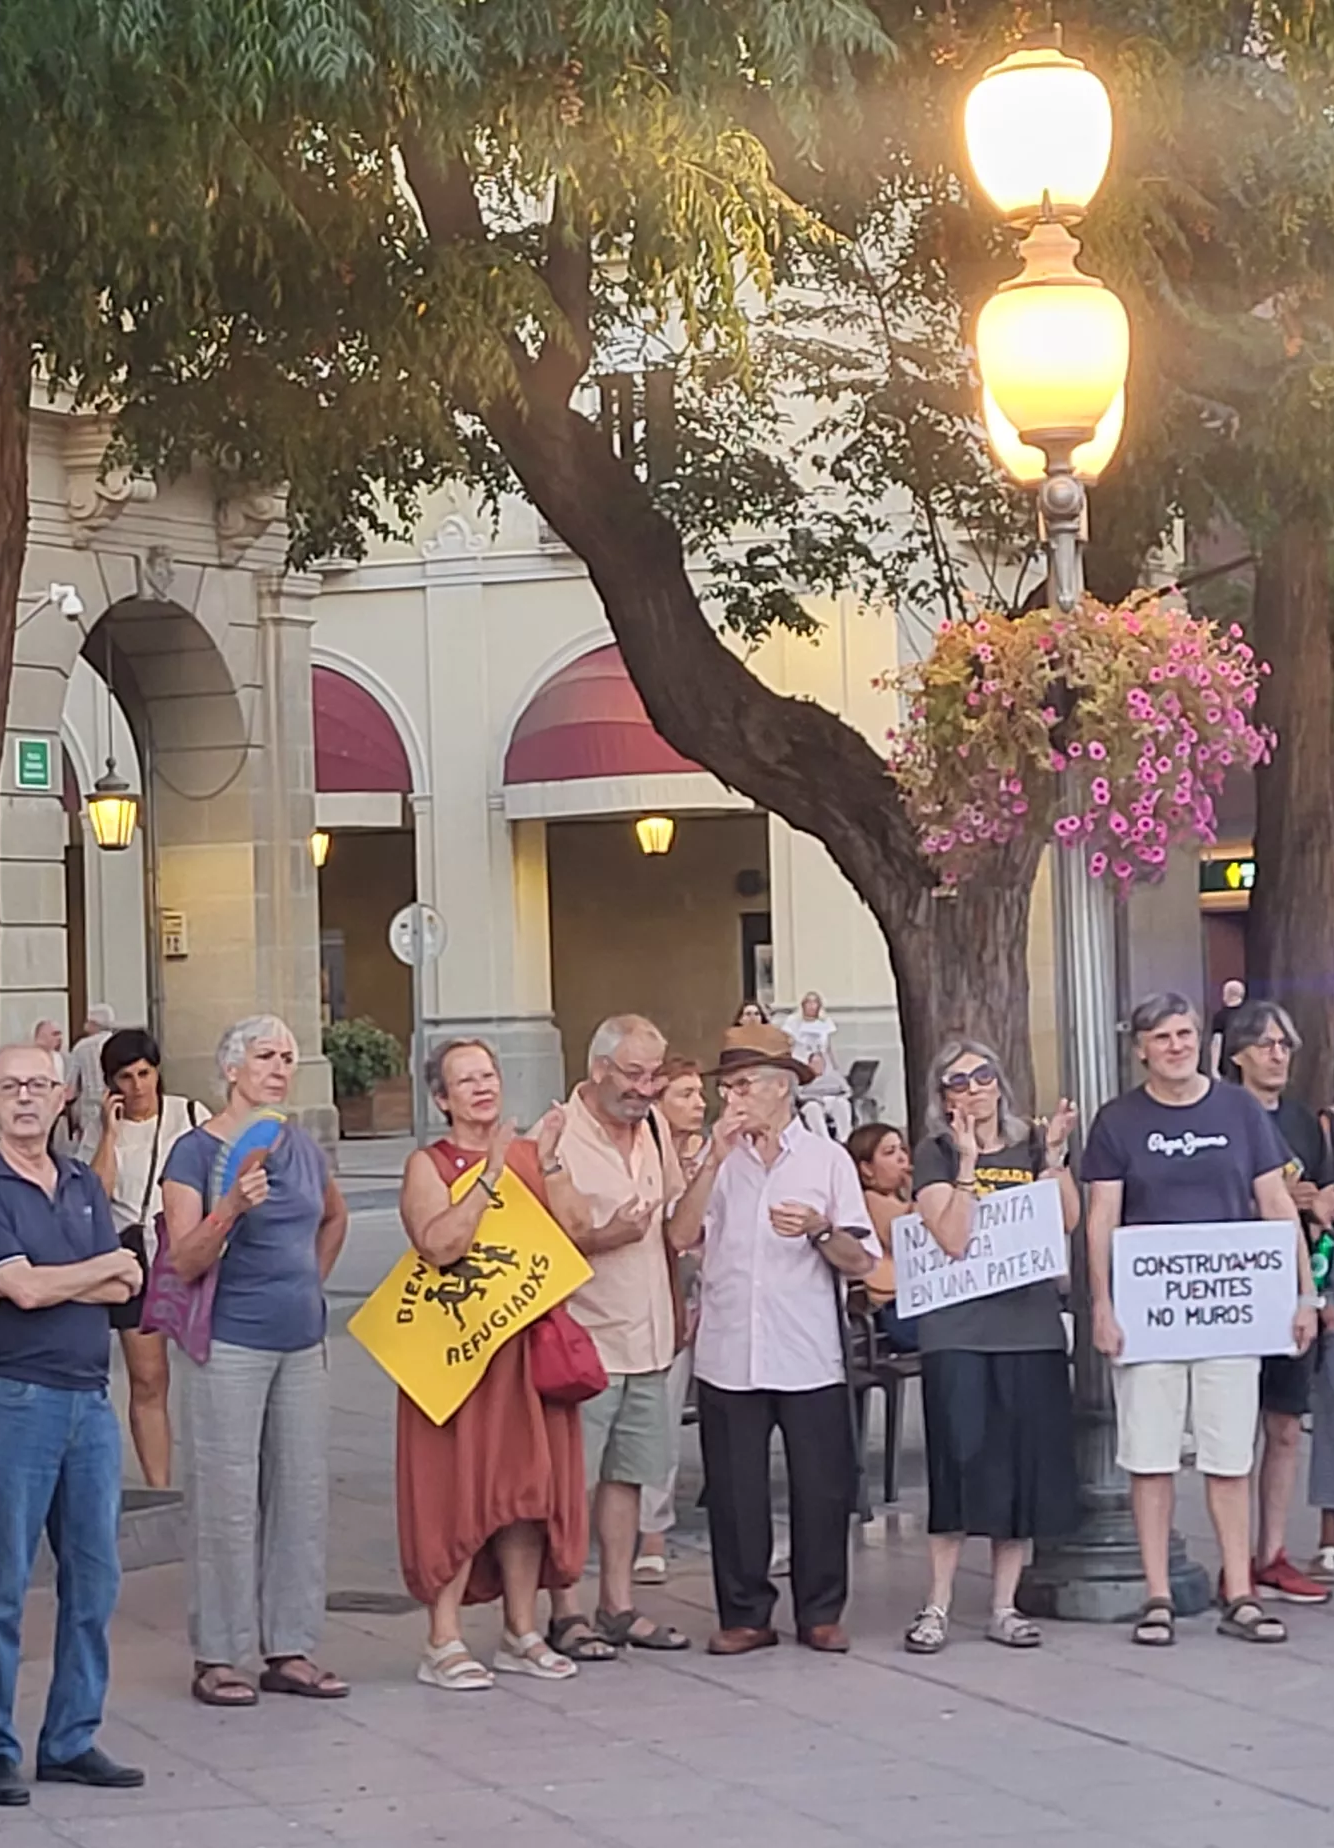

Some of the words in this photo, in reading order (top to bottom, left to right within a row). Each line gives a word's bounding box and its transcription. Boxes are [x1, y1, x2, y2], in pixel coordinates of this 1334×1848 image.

[1133, 1250, 1282, 1277] CONSTRUYAMOS
[911, 1281, 933, 1308] EN
[939, 1268, 978, 1298] UNA
[988, 1247, 1055, 1288] PATERA
[1166, 1277, 1252, 1300] PUENTES
[446, 1254, 549, 1366] REFUGIADXS
[1147, 1307, 1174, 1327] NO
[1185, 1304, 1252, 1326] MUROS
